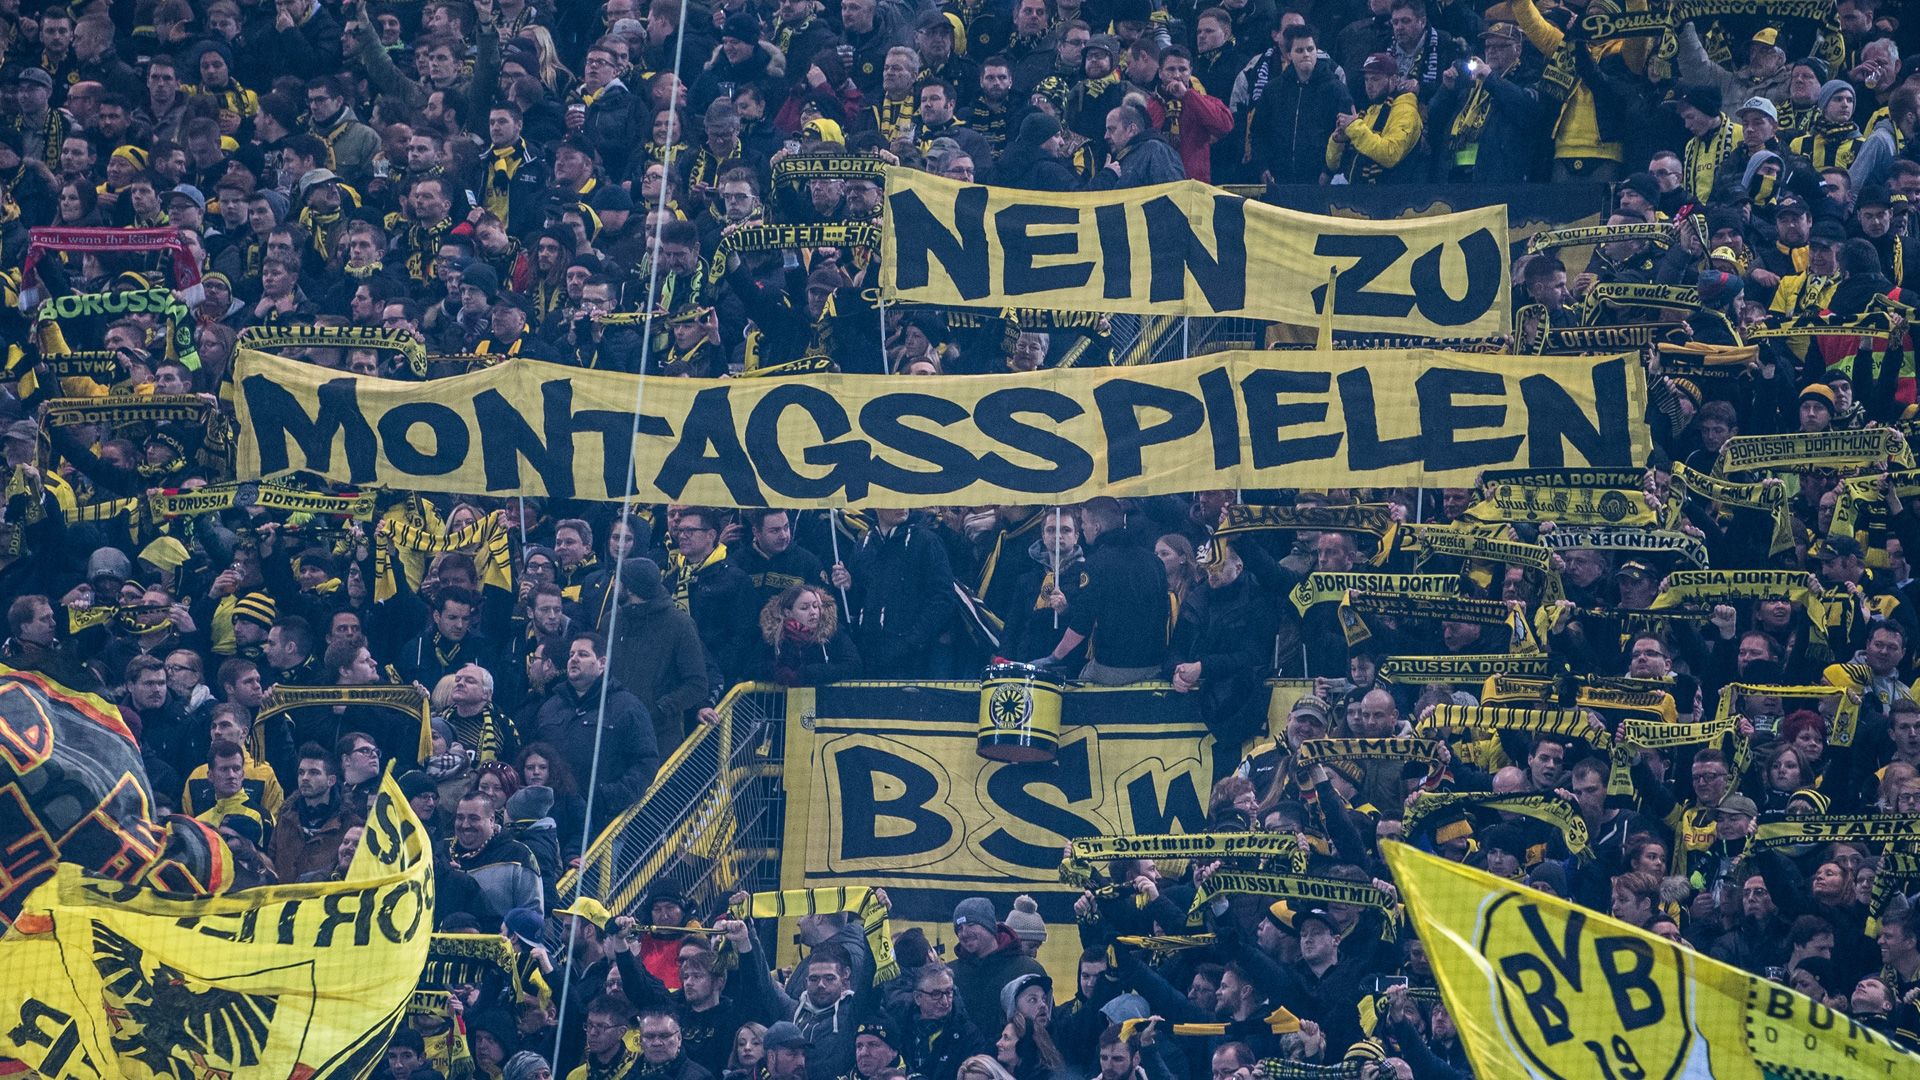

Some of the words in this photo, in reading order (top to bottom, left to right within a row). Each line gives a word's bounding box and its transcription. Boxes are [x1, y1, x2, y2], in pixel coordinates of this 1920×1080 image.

[780, 160, 824, 172] USSIA
[828, 160, 884, 172] DORTM
[68, 236, 102, 244] wenn
[105, 236, 125, 244] Ihr
[1556, 228, 1601, 239] YOU'LL
[1606, 224, 1655, 235] NEVER
[889, 186, 1246, 318] NEIN
[1311, 227, 1501, 326] ZU
[1633, 284, 1669, 299] walk
[240, 327, 291, 344] NUR
[301, 326, 351, 337] DER
[360, 327, 412, 343] BVB
[1561, 327, 1658, 347] OFFENSIVE
[52, 408, 199, 426] Dortmund
[242, 353, 1632, 507] MONTAGSSPIELEN
[1730, 441, 1795, 460] BORUSSIA
[1805, 436, 1880, 452] DORTMUND
[168, 494, 228, 512] BORUSSIA
[262, 492, 349, 510] DORTMUND
[1473, 537, 1549, 562] Dortmund
[1314, 575, 1393, 593] BORUSSIA
[1627, 725, 1691, 739] DORTMU
[1300, 739, 1434, 760] RTMUN
[1785, 814, 1867, 822] GEMEINSAM
[1802, 821, 1915, 835] STARK
[1077, 840, 1103, 855] In
[1113, 834, 1215, 853] Dortmund
[1764, 838, 1787, 847] WIR
[1789, 835, 1814, 843] FÜR
[1202, 874, 1289, 897] BORUSSIA
[412, 991, 449, 1010] RTM
